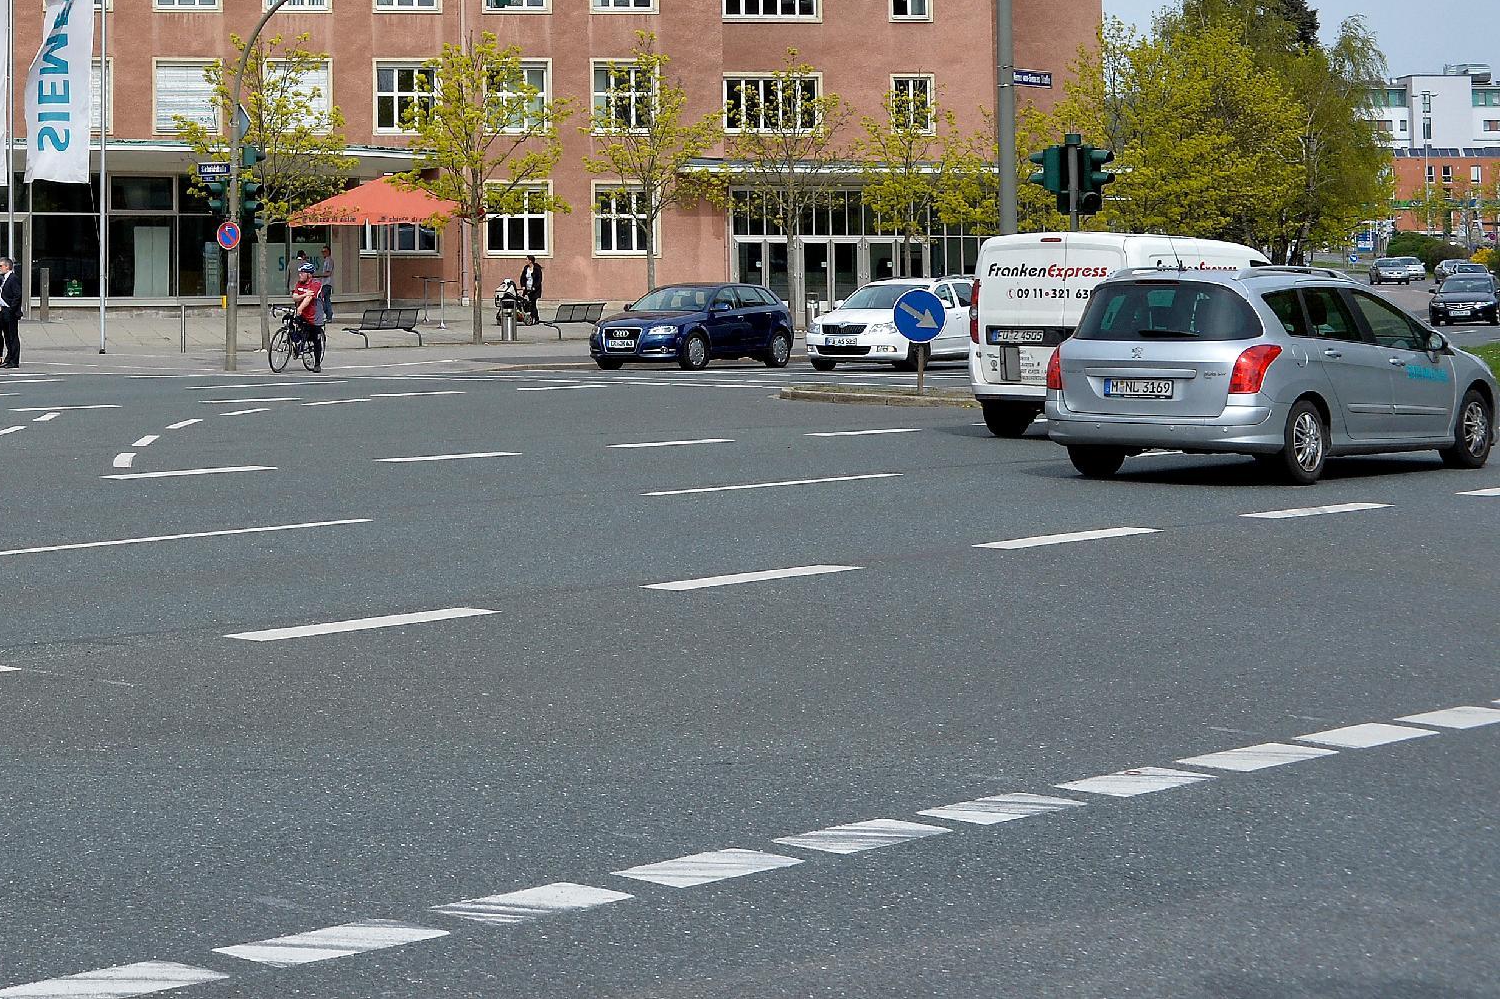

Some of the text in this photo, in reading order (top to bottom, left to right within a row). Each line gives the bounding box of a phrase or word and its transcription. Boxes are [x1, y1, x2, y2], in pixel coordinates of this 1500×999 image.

[1111, 380, 1170, 394] M NL 3169
